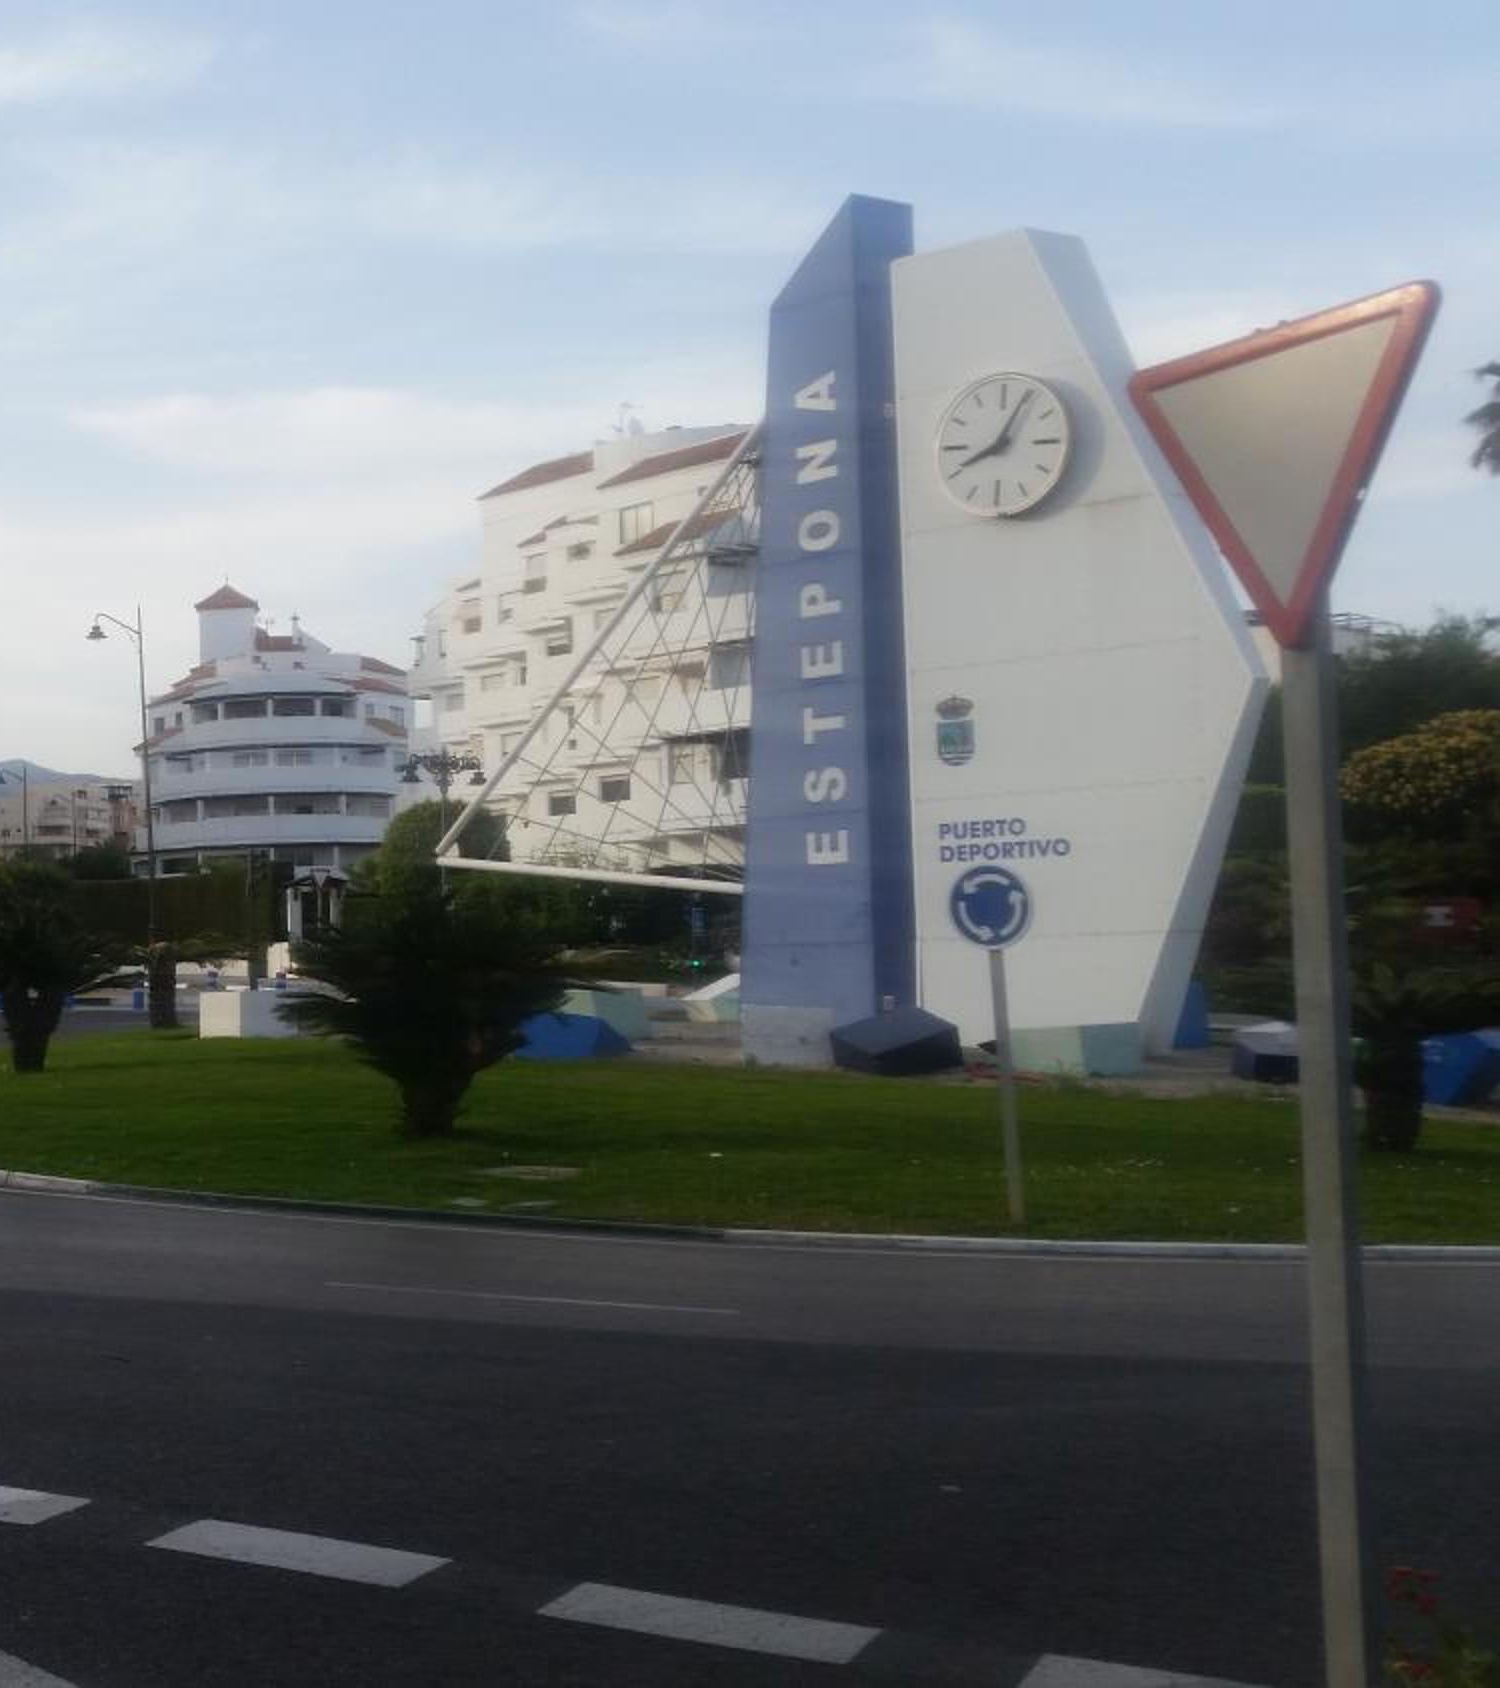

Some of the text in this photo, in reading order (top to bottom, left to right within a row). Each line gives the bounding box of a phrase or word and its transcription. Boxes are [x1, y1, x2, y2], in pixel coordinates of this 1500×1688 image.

[795, 370, 849, 865] ESTEPONA
[938, 818, 1026, 840] PUERTO
[939, 837, 1071, 863] DEPORTIVO
